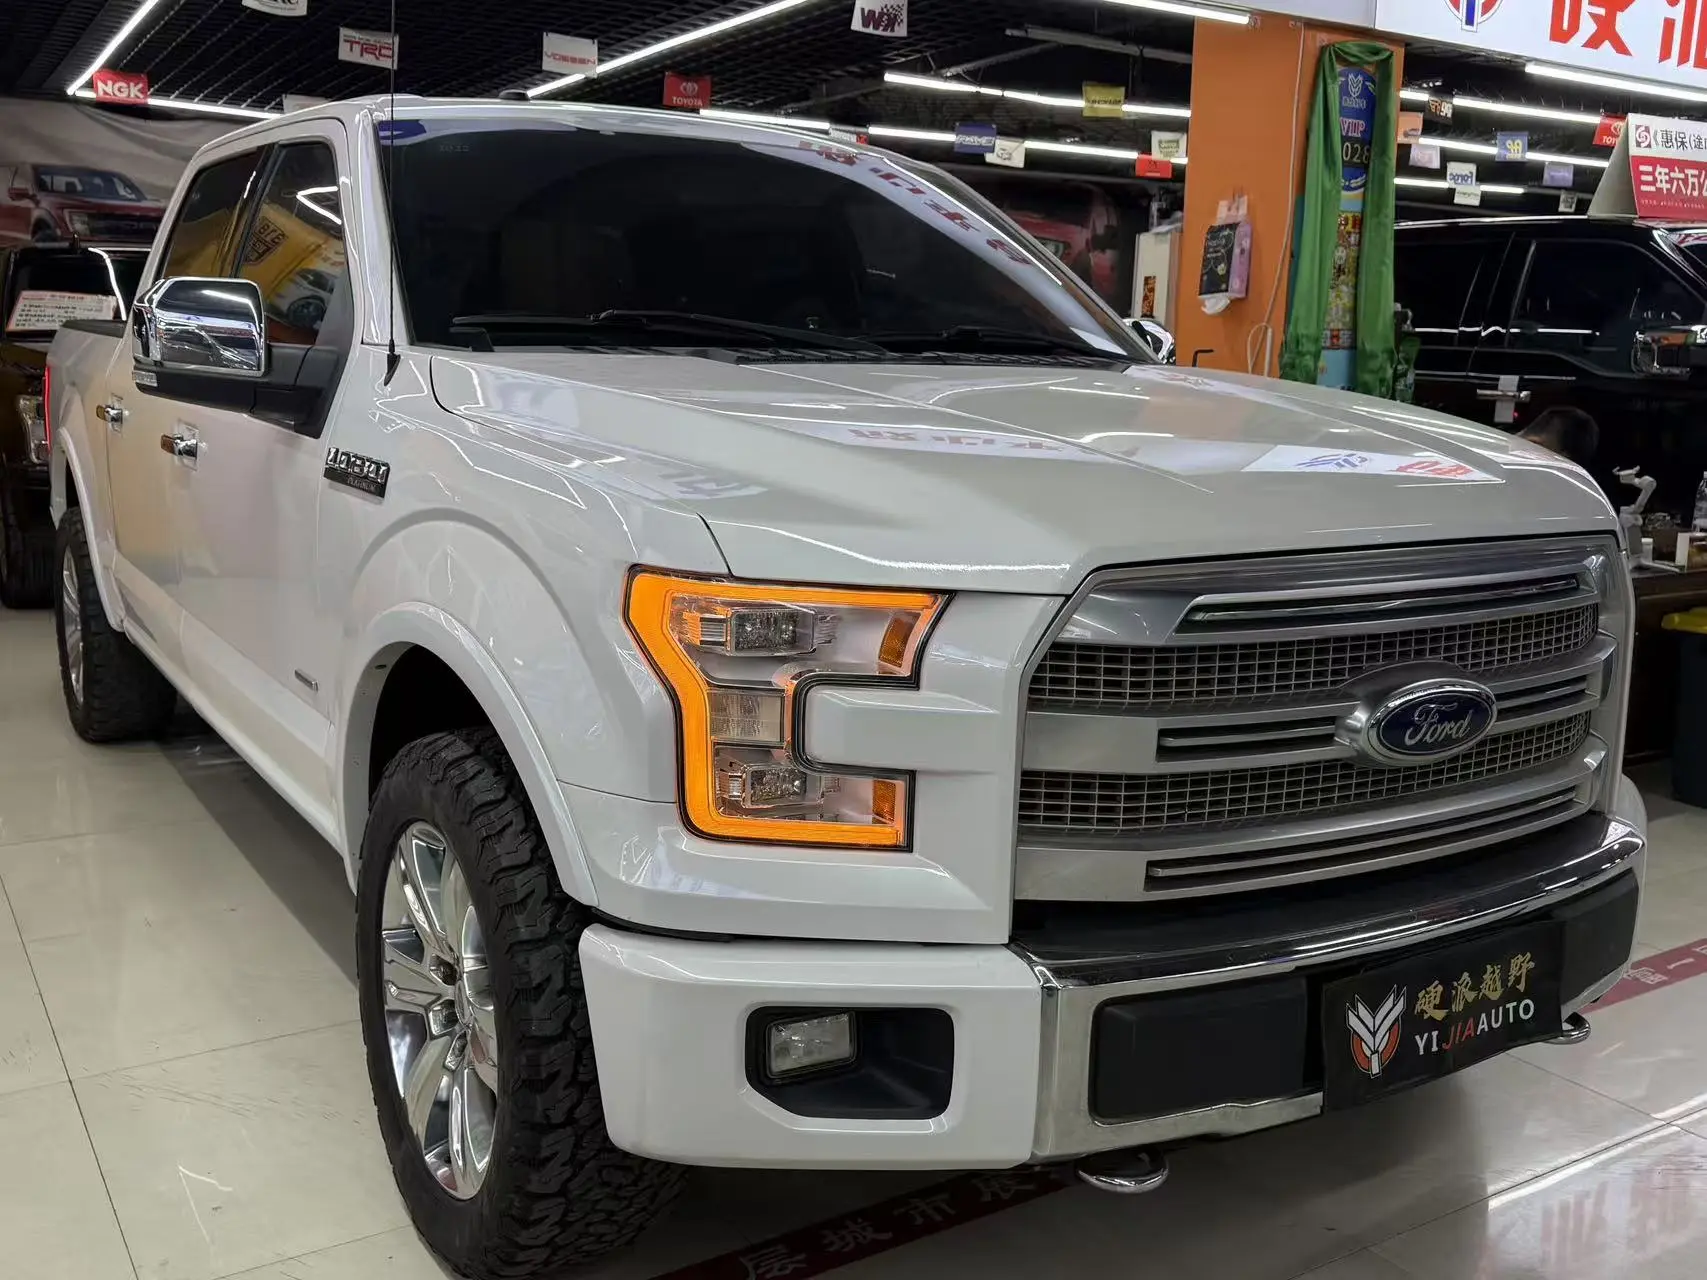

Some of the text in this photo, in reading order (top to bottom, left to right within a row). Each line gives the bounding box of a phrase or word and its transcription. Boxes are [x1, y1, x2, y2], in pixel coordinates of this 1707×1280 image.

[97, 79, 144, 99] NGK
[672, 96, 703, 107] TOYOTA
[1339, 117, 1366, 138] VIP
[1652, 129, 1707, 152] 《惠保(途
[1404, 702, 1473, 746] Ford
[1414, 951, 1536, 1021] 硬派越野
